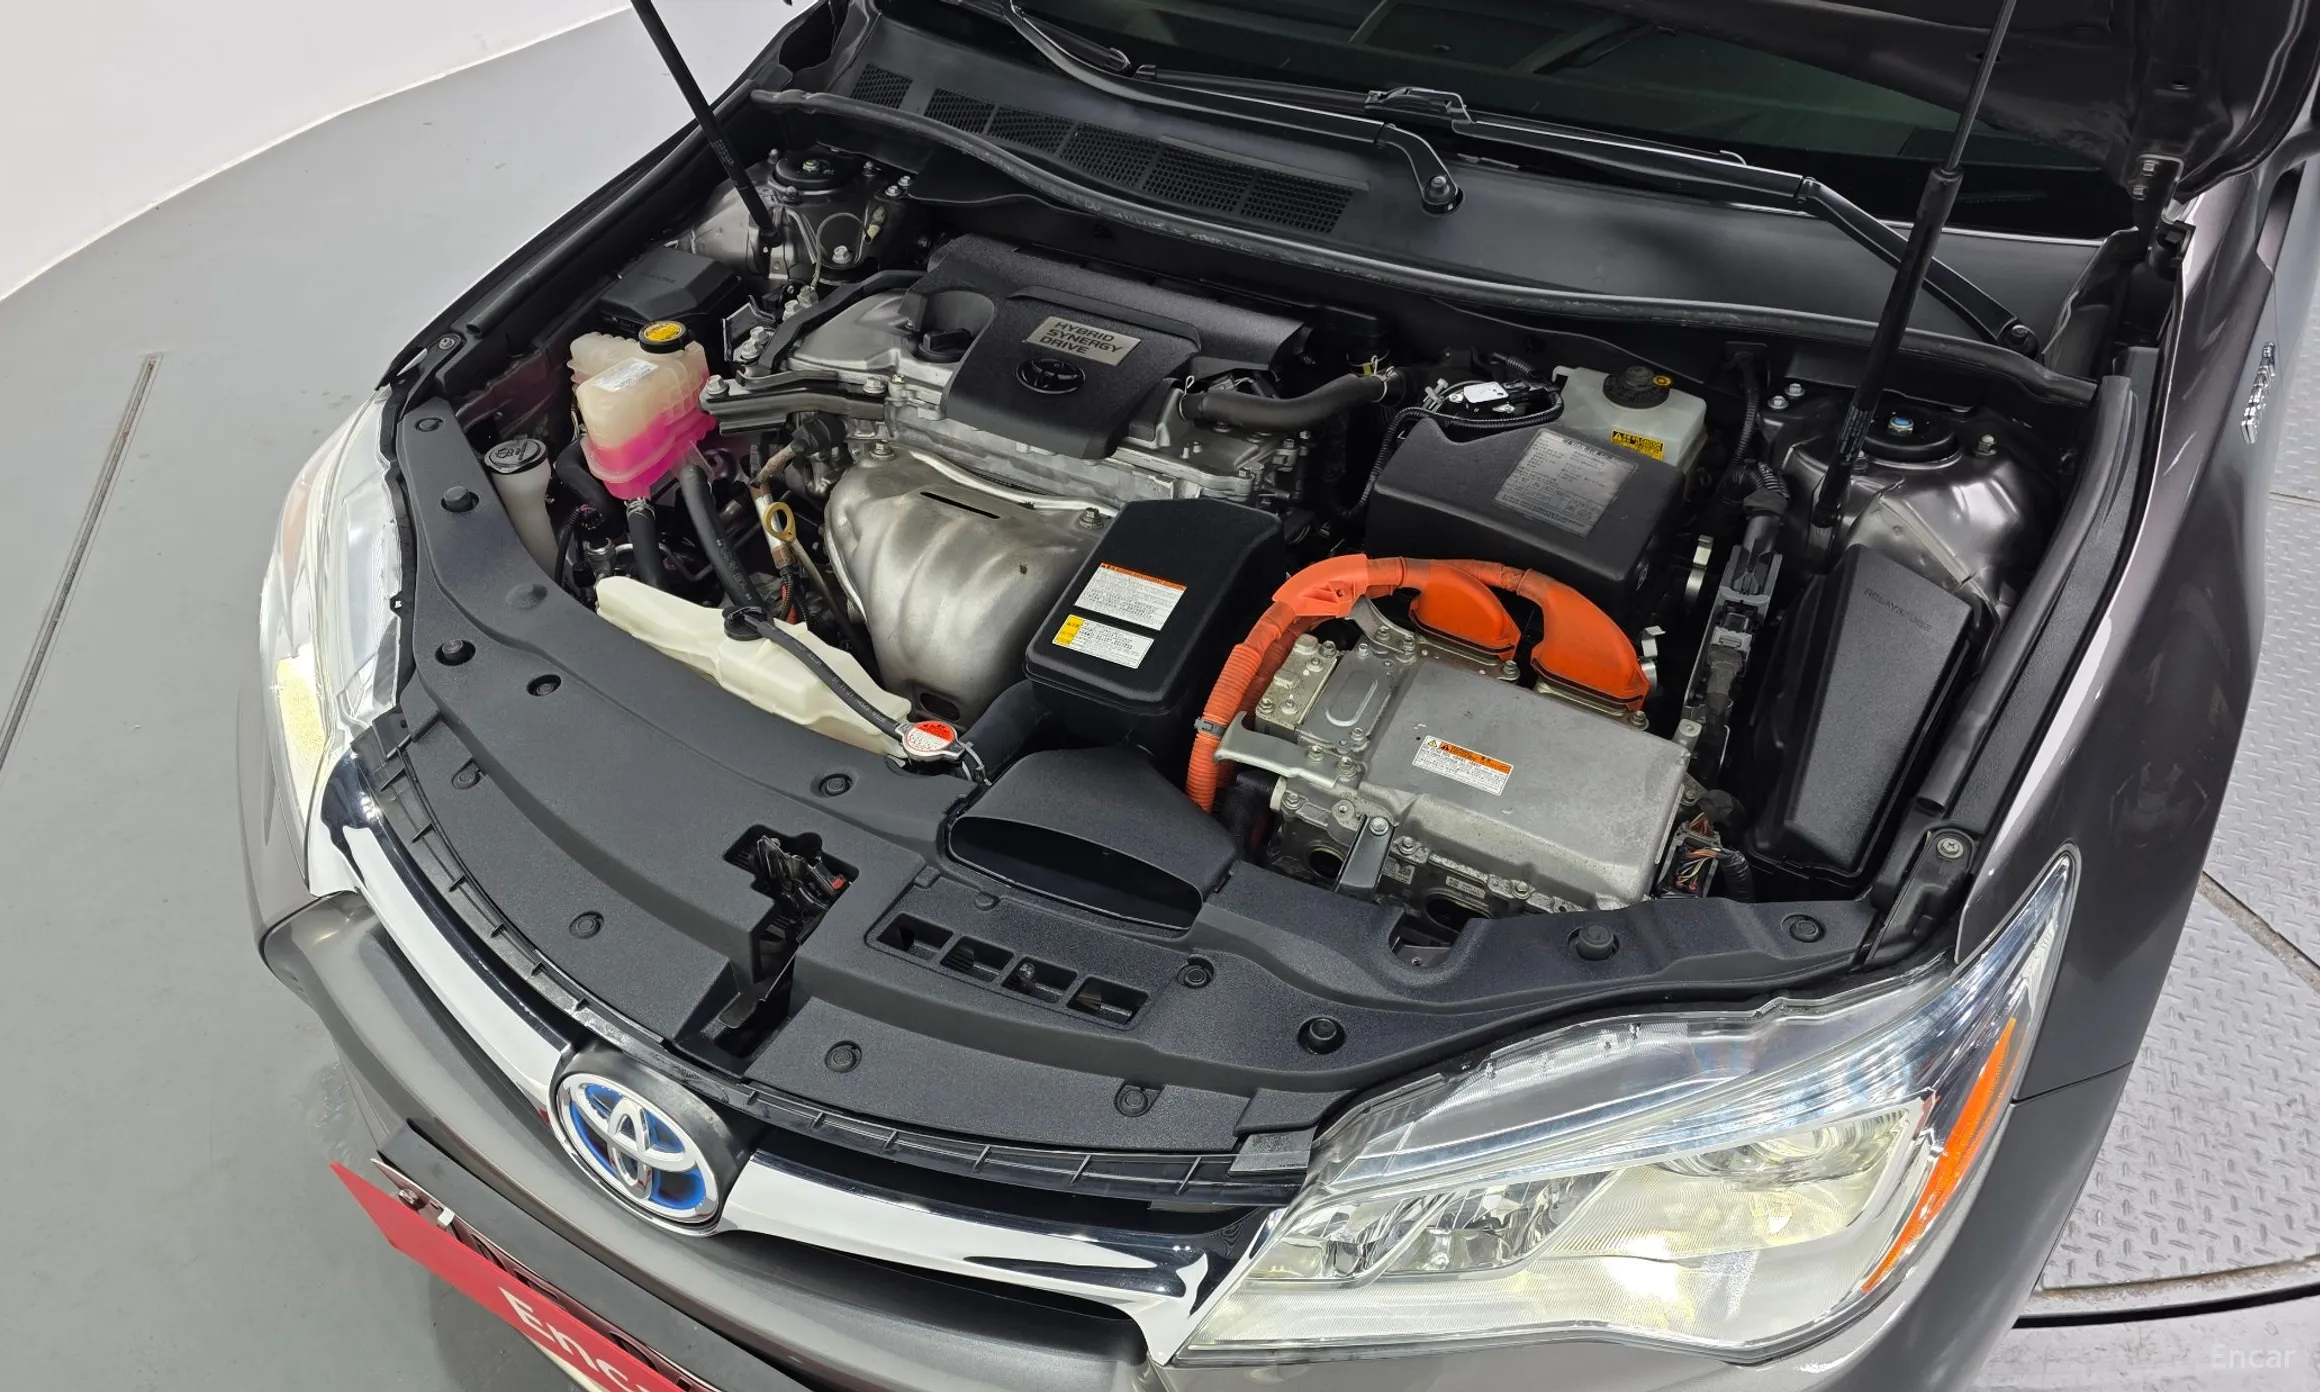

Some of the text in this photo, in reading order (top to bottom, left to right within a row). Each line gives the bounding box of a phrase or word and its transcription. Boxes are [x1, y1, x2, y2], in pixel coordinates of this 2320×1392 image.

[1046, 328, 1123, 353] SYNERGY
[1055, 321, 1115, 342] HYBRID
[1039, 336, 1091, 354] DRIVE
[498, 1286, 651, 1392] Enc
